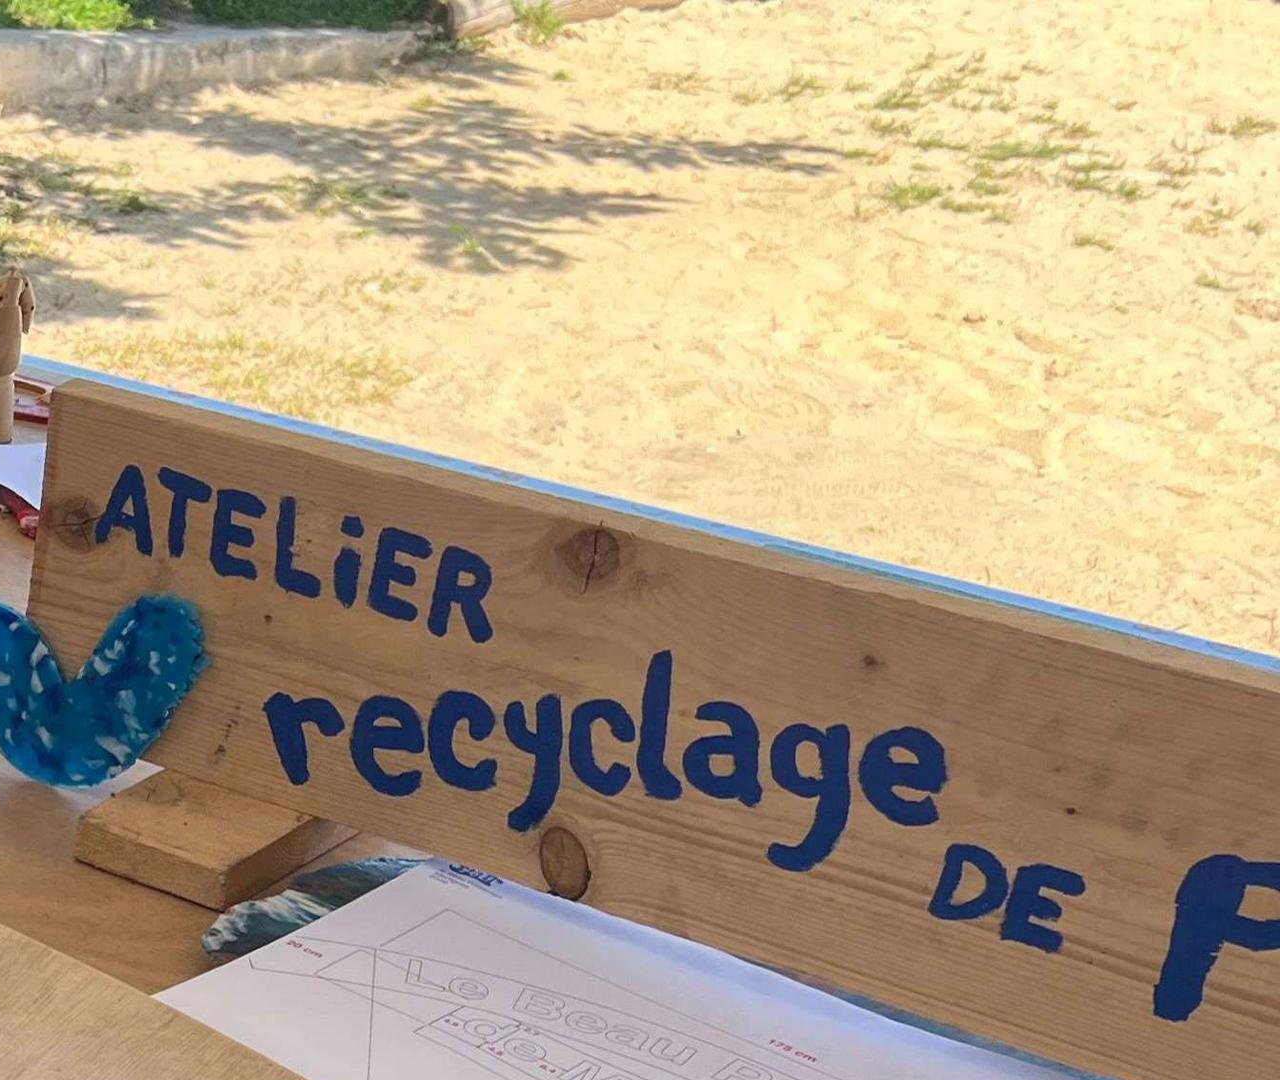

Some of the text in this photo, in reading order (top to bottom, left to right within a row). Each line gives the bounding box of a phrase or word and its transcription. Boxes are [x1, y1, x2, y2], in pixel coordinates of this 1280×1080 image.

[262, 649, 950, 872] recyclage
[303, 947, 323, 959] cm
[928, 843, 1280, 1023] DE P
[405, 958, 489, 1001] Le
[512, 987, 698, 1066] Beau
[462, 1017, 547, 1063] de
[794, 1051, 817, 1063] cm
